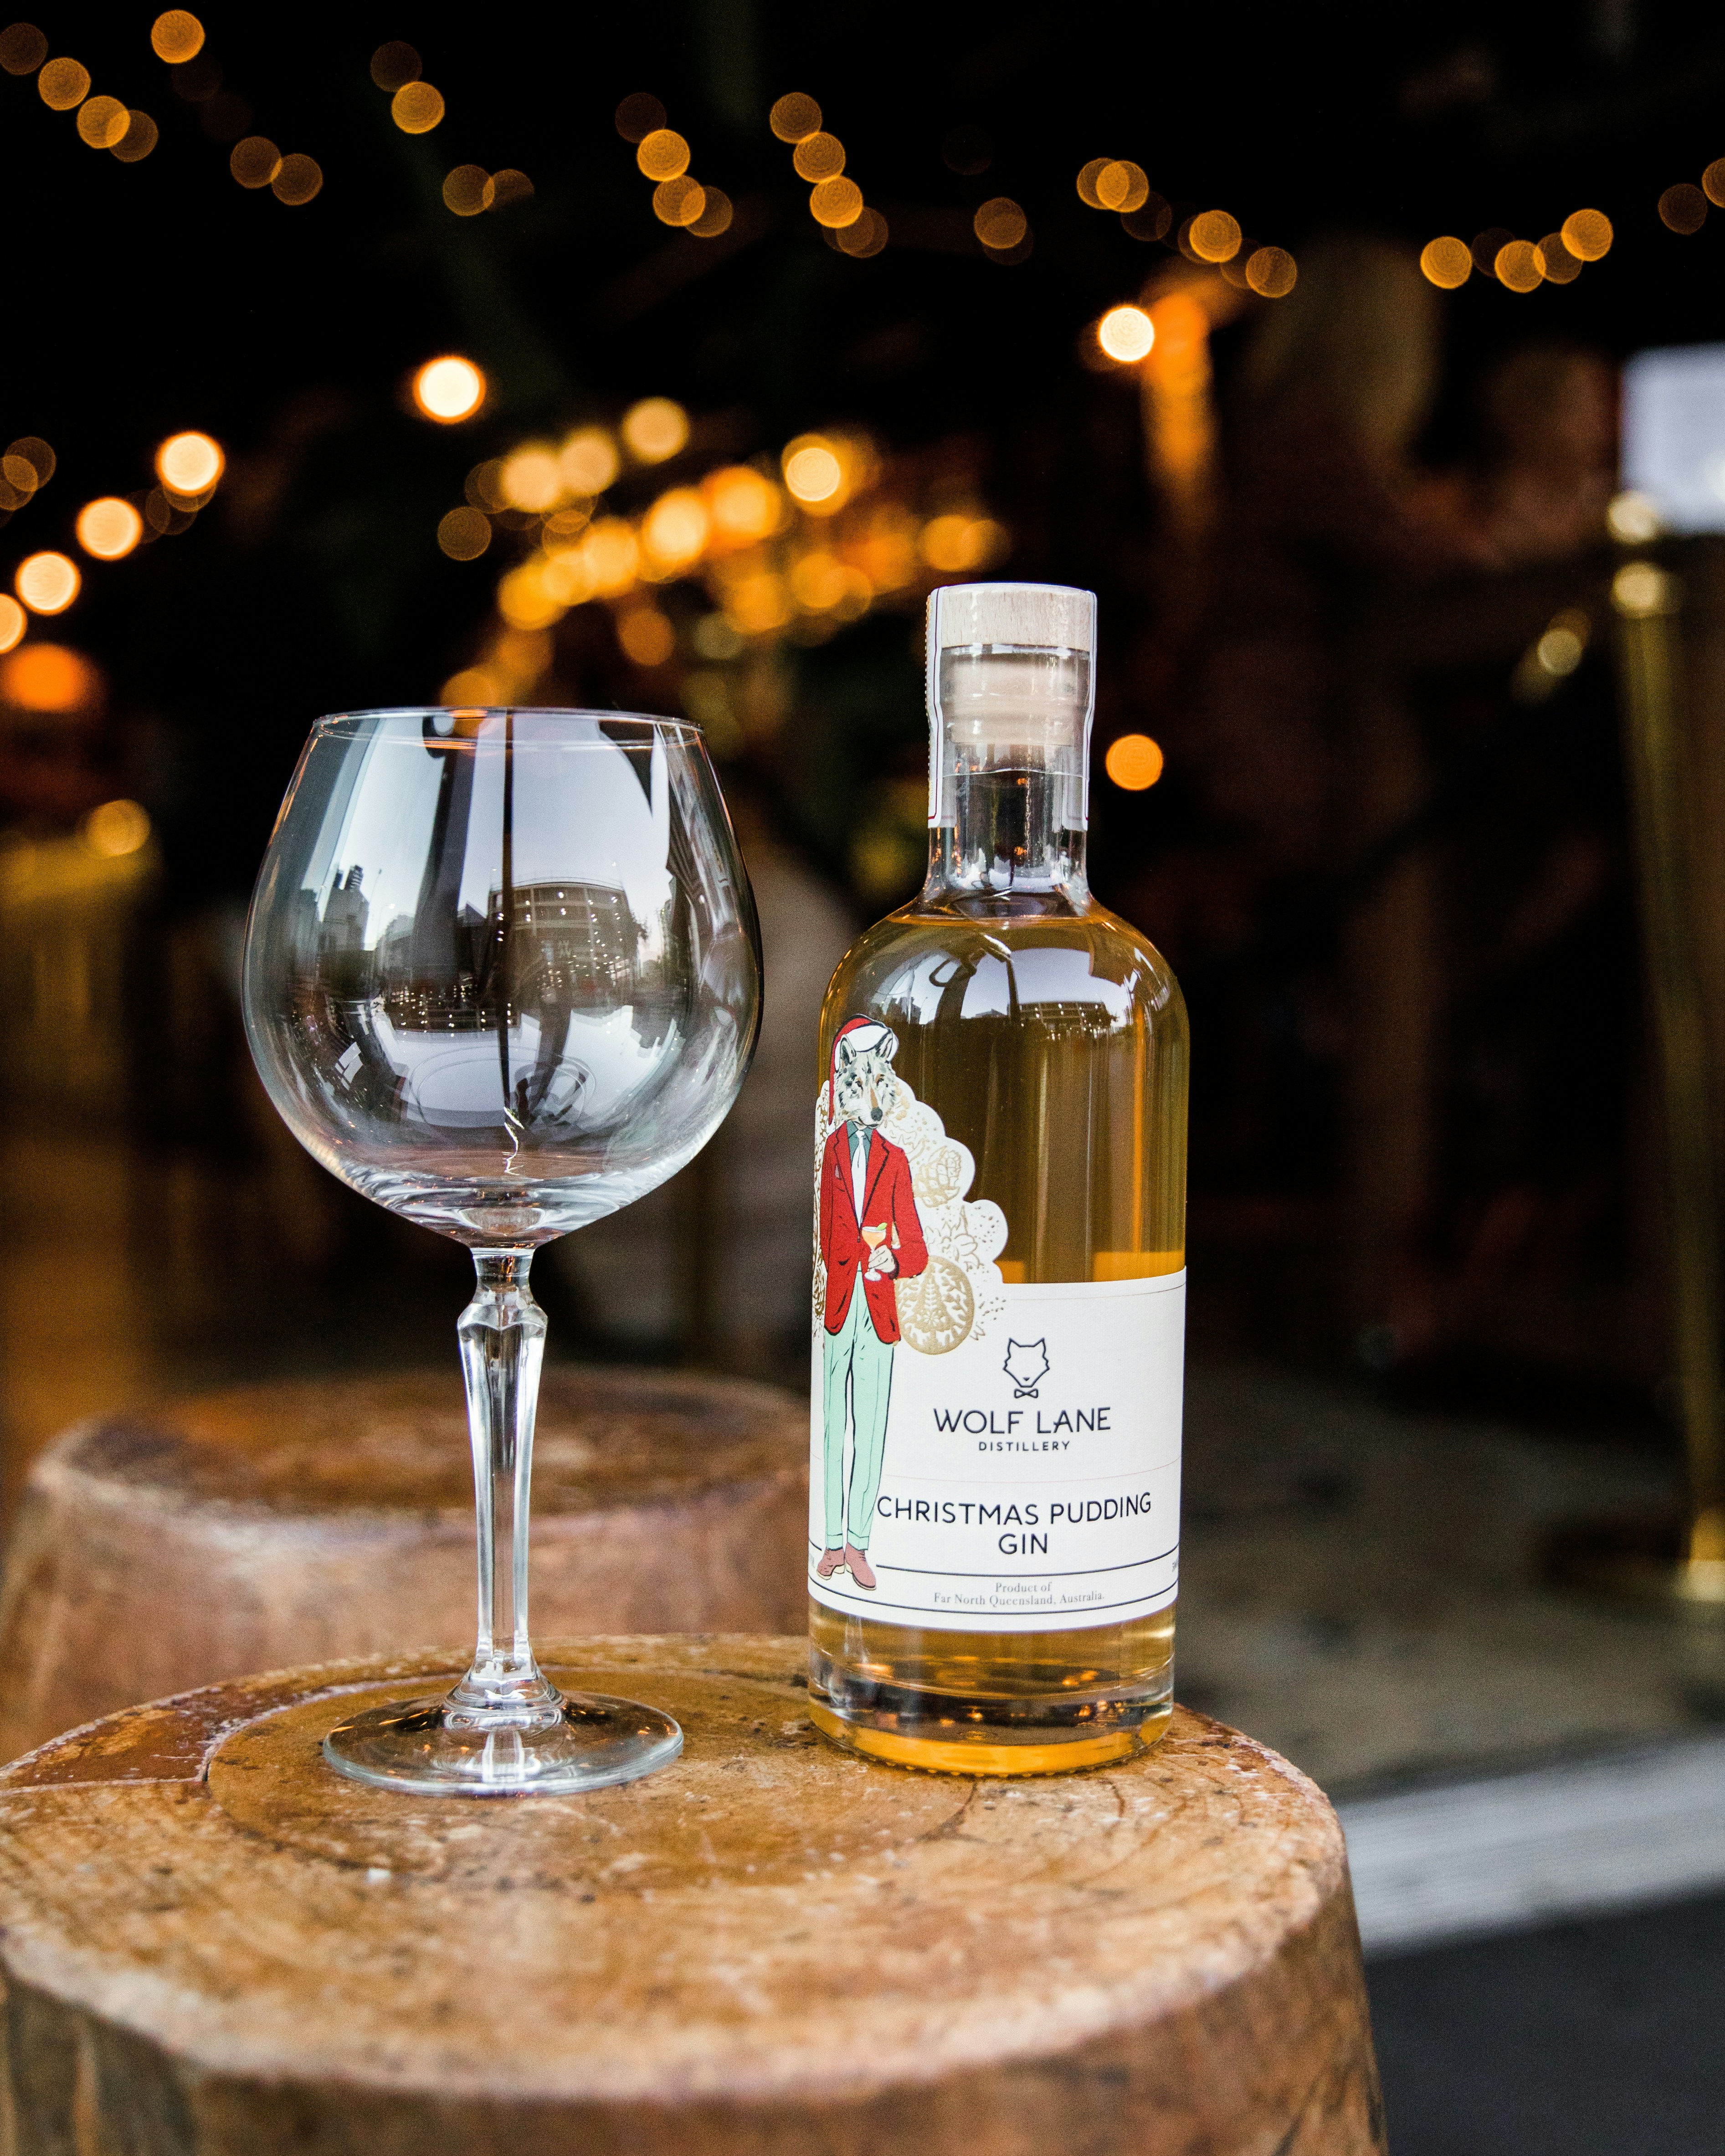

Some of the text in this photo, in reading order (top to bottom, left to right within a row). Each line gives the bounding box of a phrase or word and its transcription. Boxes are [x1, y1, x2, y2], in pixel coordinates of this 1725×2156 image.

[933, 1406, 1111, 1435] WOLF LANE
[978, 1440, 1070, 1452] DISTILLERY
[877, 1491, 1152, 1526] CHRISTMAS PUDDING
[998, 1532, 1048, 1555] GIN
[995, 1581, 1052, 1592] Product of
[934, 1591, 1104, 1607] Far North Queensland, Australia.
